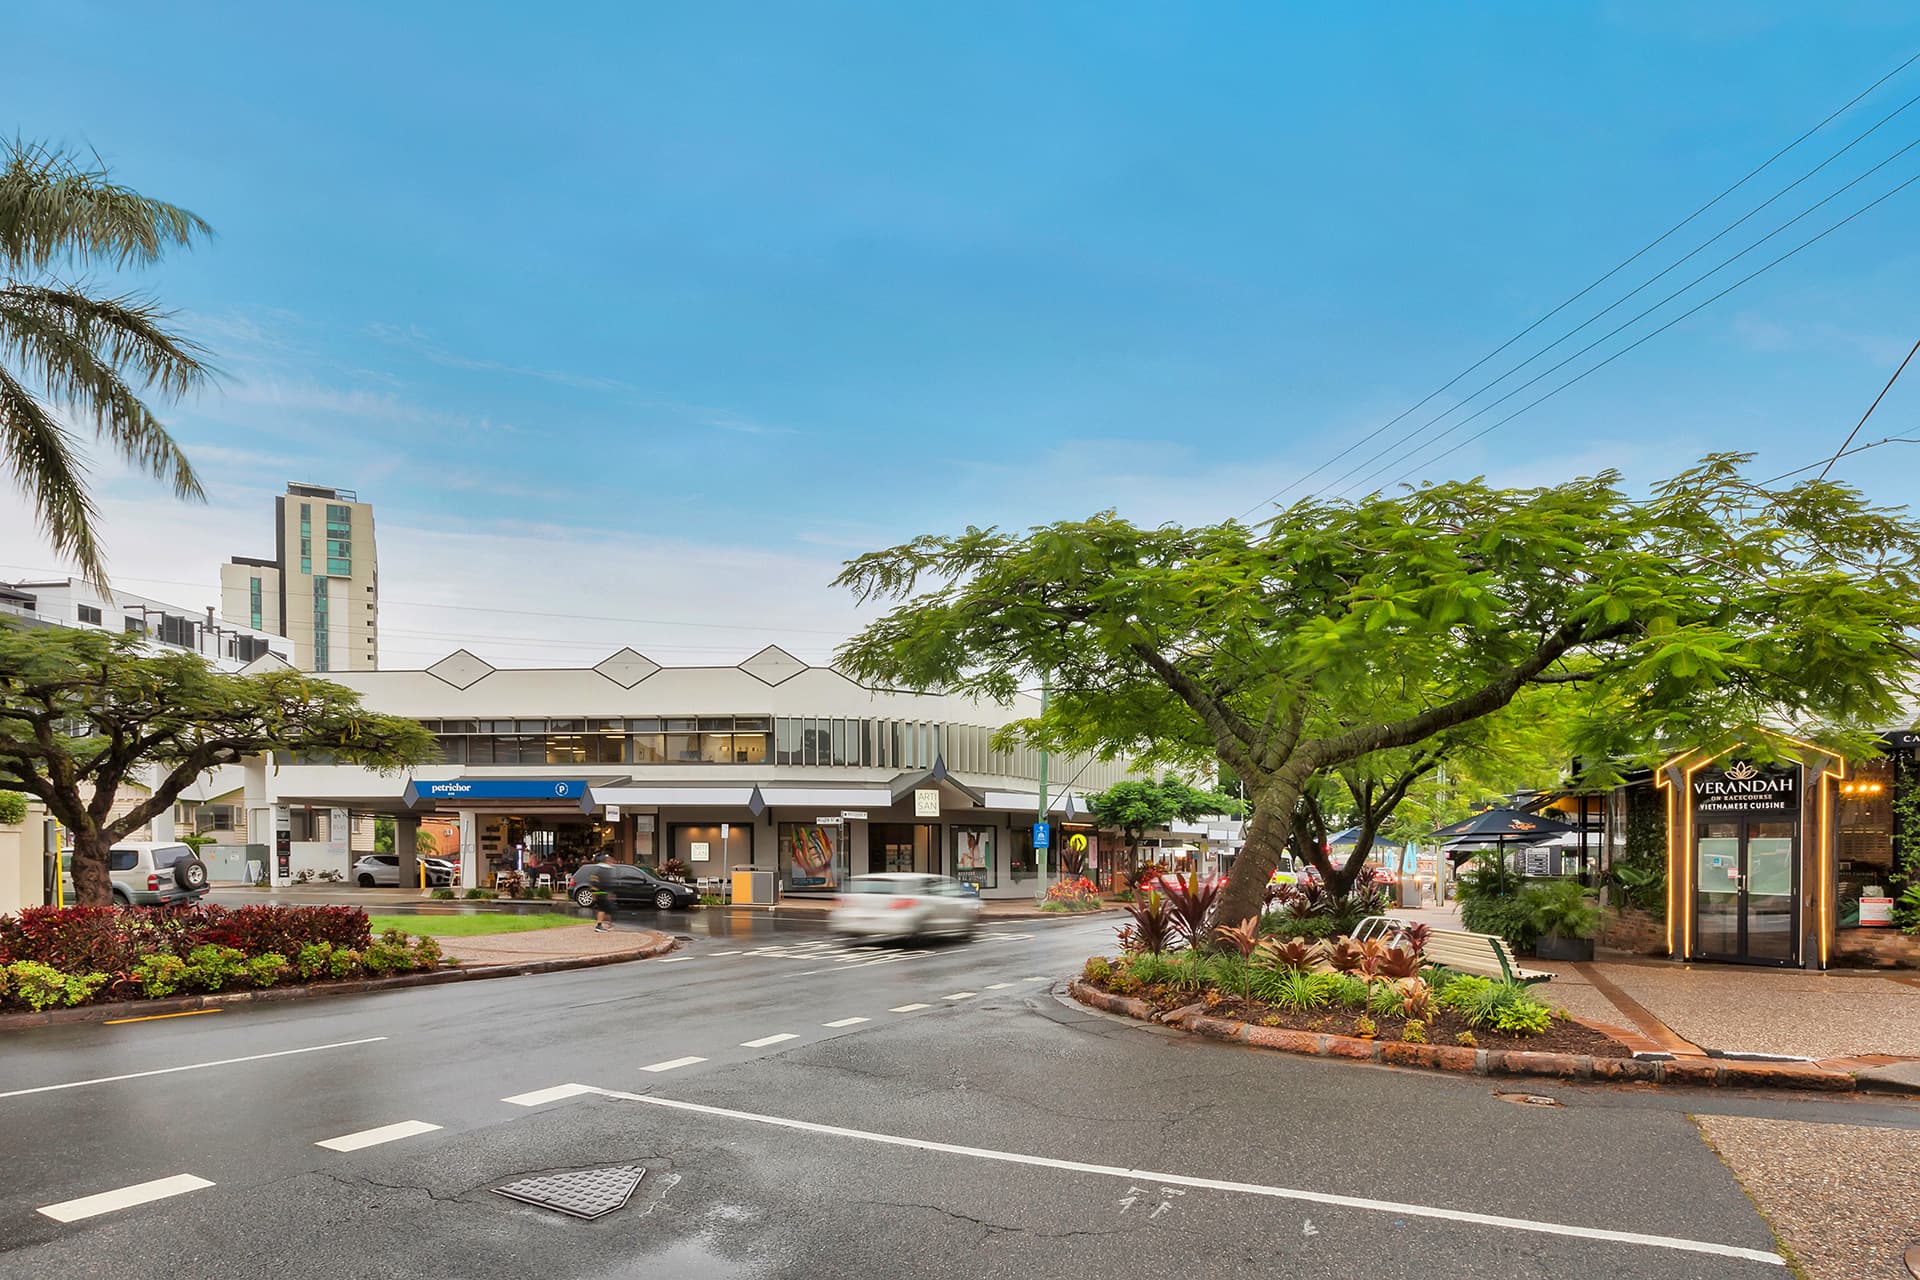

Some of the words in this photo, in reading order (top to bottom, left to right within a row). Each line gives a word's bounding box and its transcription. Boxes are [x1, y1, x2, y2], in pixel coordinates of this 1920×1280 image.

[431, 783, 472, 793] petrichor
[1694, 778, 1793, 795] VERANDAH
[918, 792, 937, 800] ARTI
[918, 801, 937, 810] SAN
[1699, 803, 1748, 811] VIETNAMESE
[1749, 801, 1785, 809] CUISINE
